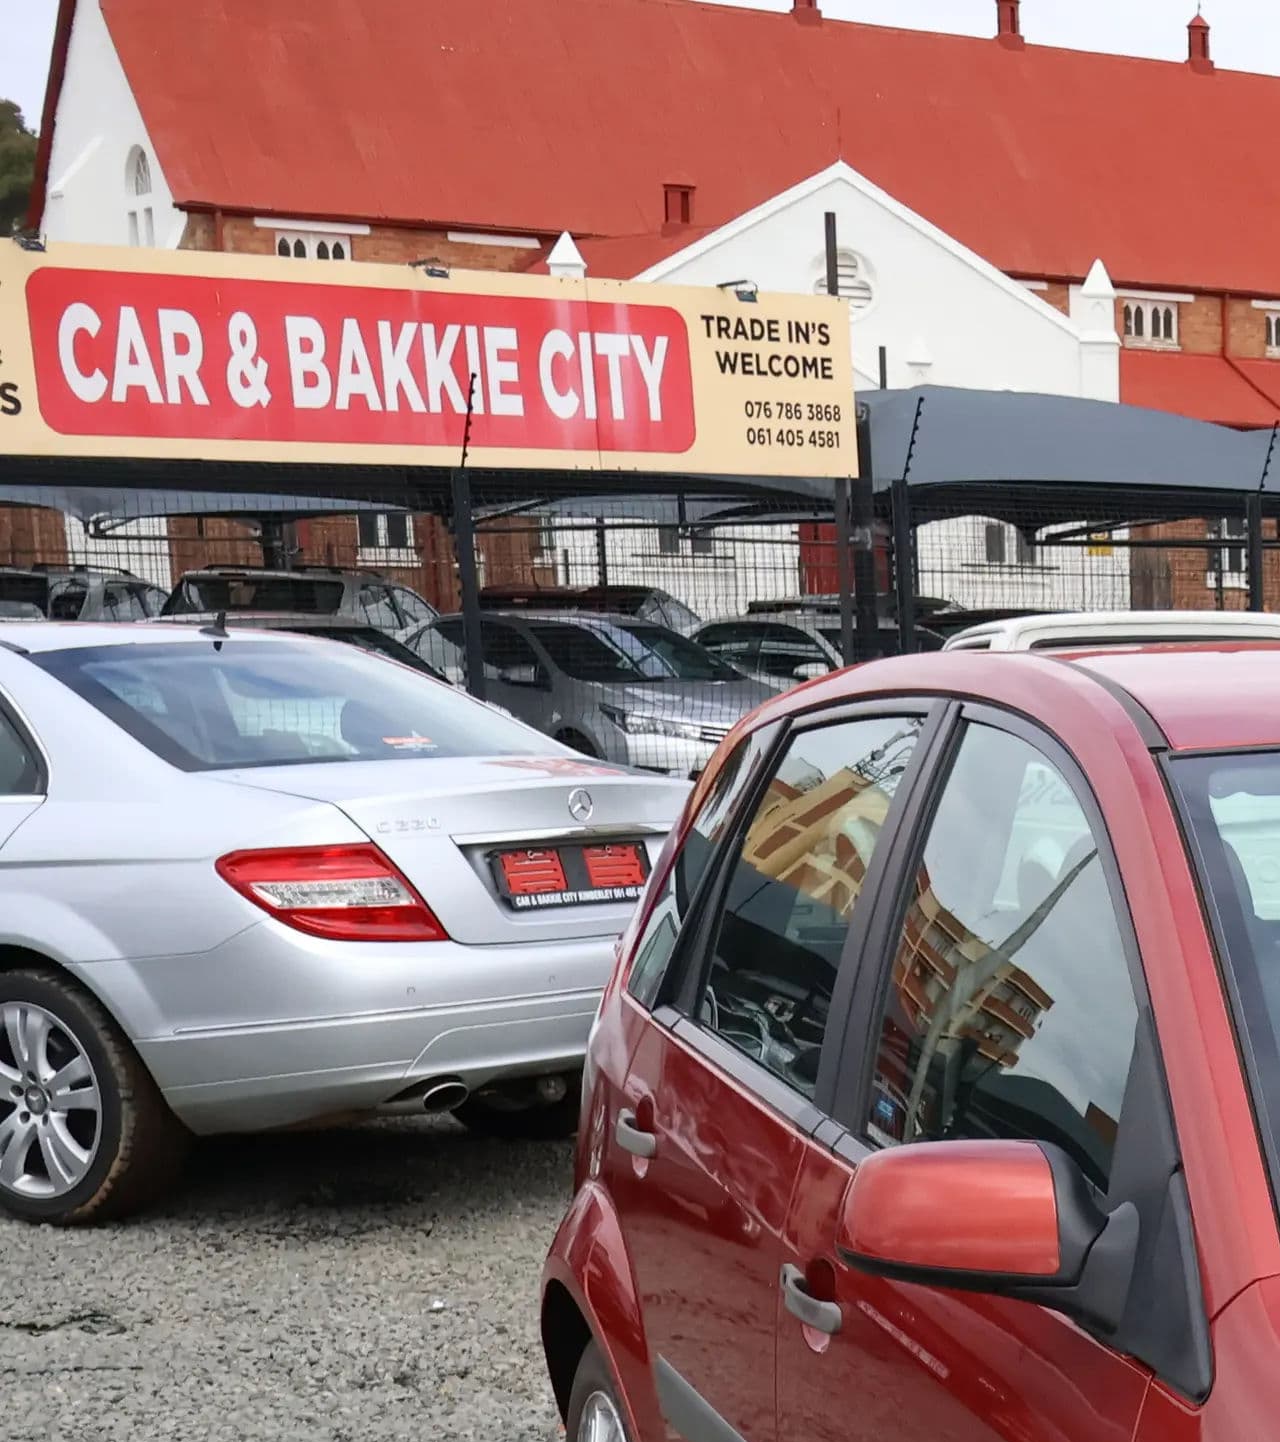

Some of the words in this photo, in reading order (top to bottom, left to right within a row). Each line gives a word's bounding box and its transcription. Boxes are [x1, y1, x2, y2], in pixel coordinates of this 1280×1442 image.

[700, 314, 780, 342] TRADE
[788, 320, 830, 346] IN'S
[58, 302, 210, 405] CAR
[227, 311, 272, 408] &
[285, 315, 524, 416] BAKKIE
[539, 329, 669, 421] CITY
[715, 351, 833, 380] WELCOME
[745, 400, 772, 419] 076
[776, 402, 802, 420] 786
[807, 404, 841, 422] 3868
[747, 428, 772, 445] 061
[776, 429, 804, 447] 405
[808, 431, 840, 448] 4581
